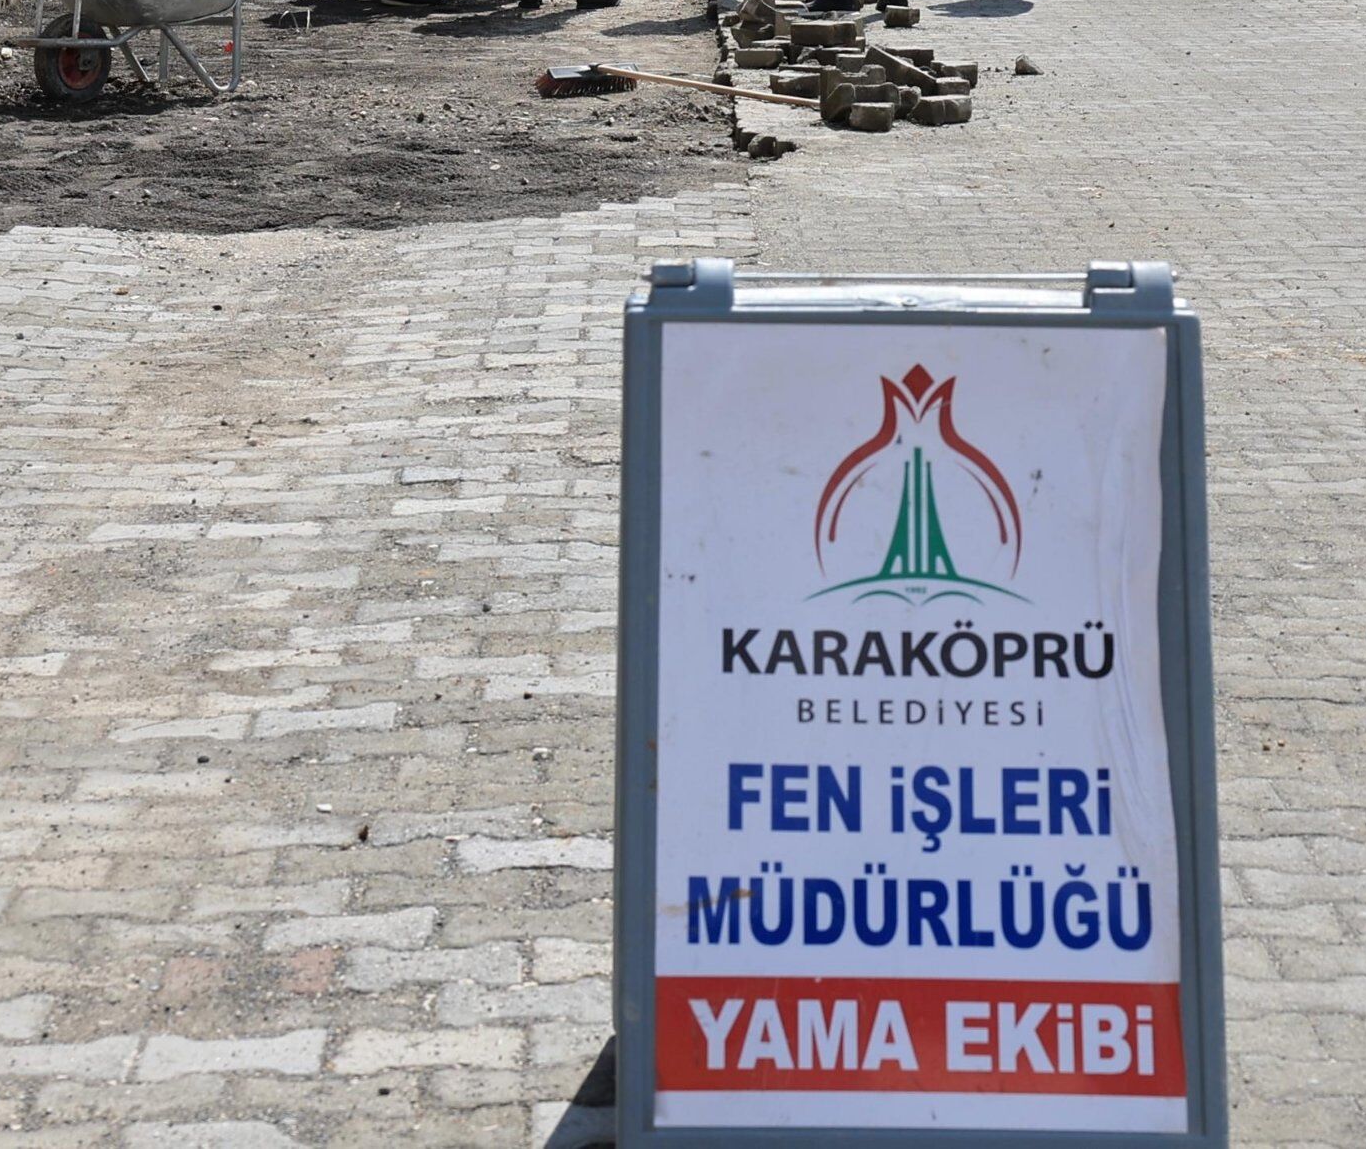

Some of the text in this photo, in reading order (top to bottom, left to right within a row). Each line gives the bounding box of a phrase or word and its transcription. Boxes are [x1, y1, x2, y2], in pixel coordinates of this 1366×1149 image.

[721, 619, 1115, 679] KARAKÖPRÜ
[728, 763, 861, 833] FEN
[686, 861, 1153, 952] MÜDÜRLÜĞÜ
[688, 998, 920, 1071] YAMA
